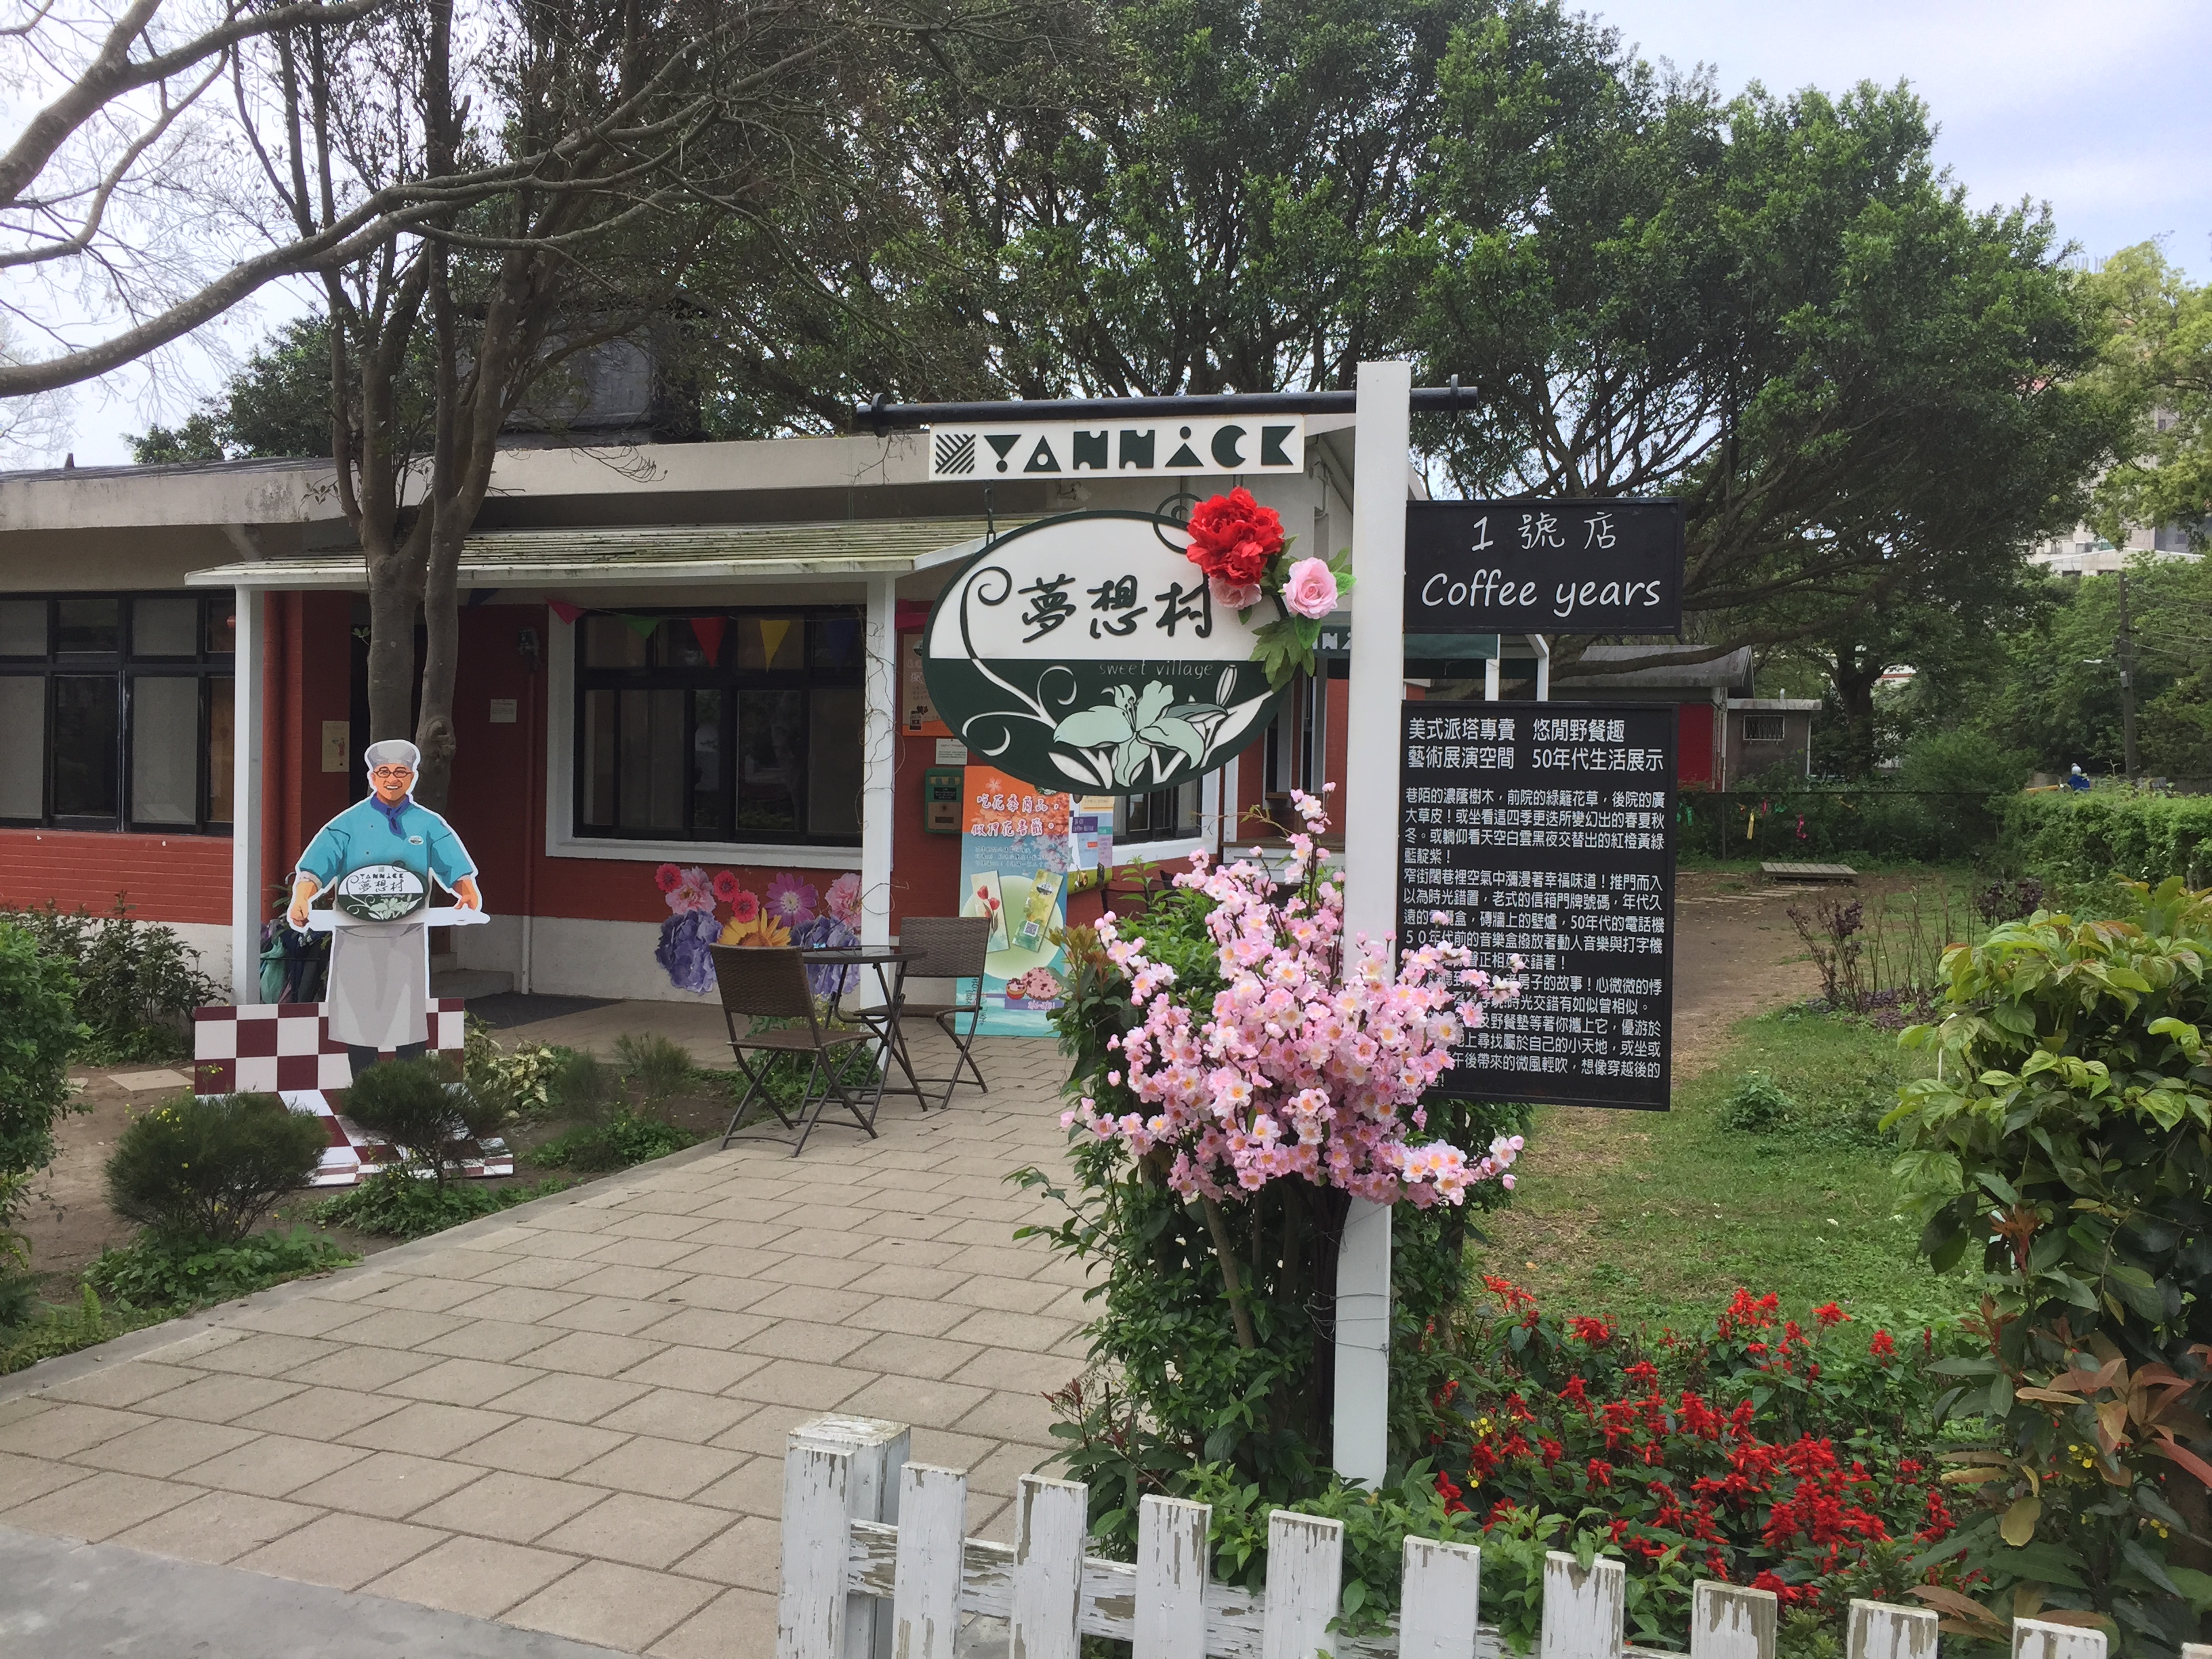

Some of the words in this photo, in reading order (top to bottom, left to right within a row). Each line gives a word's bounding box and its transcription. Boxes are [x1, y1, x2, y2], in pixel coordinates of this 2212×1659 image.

[1422, 569, 1538, 607] Coffee
[1553, 580, 1661, 617] years
[1018, 573, 1212, 644] 夢想村
[1099, 659, 1147, 676] sweet
[1156, 659, 1214, 680] village
[1409, 718, 1515, 741] 美式派塔專賣
[1532, 718, 1624, 743] 悠閒野餐趣
[1408, 745, 1515, 770] 藝術展演空間
[1532, 747, 1664, 772] 50年代生活展示
[1405, 808, 1665, 830] 大草皮！或坐看這四季更迭所變幻出的春夏秋
[1405, 827, 1665, 851] 冬。或躺仰看天空白雲黑夜交替出的紅橙黃綠
[1404, 847, 1450, 865] 藍靛紫！
[358, 878, 405, 894] 夢想村
[1403, 888, 1663, 911] 以為時光錯置，老式的信箱門牌號碼，年代久
[1447, 1050, 1661, 1079] 午後帶來的微風輕吹，想像穿越後的
